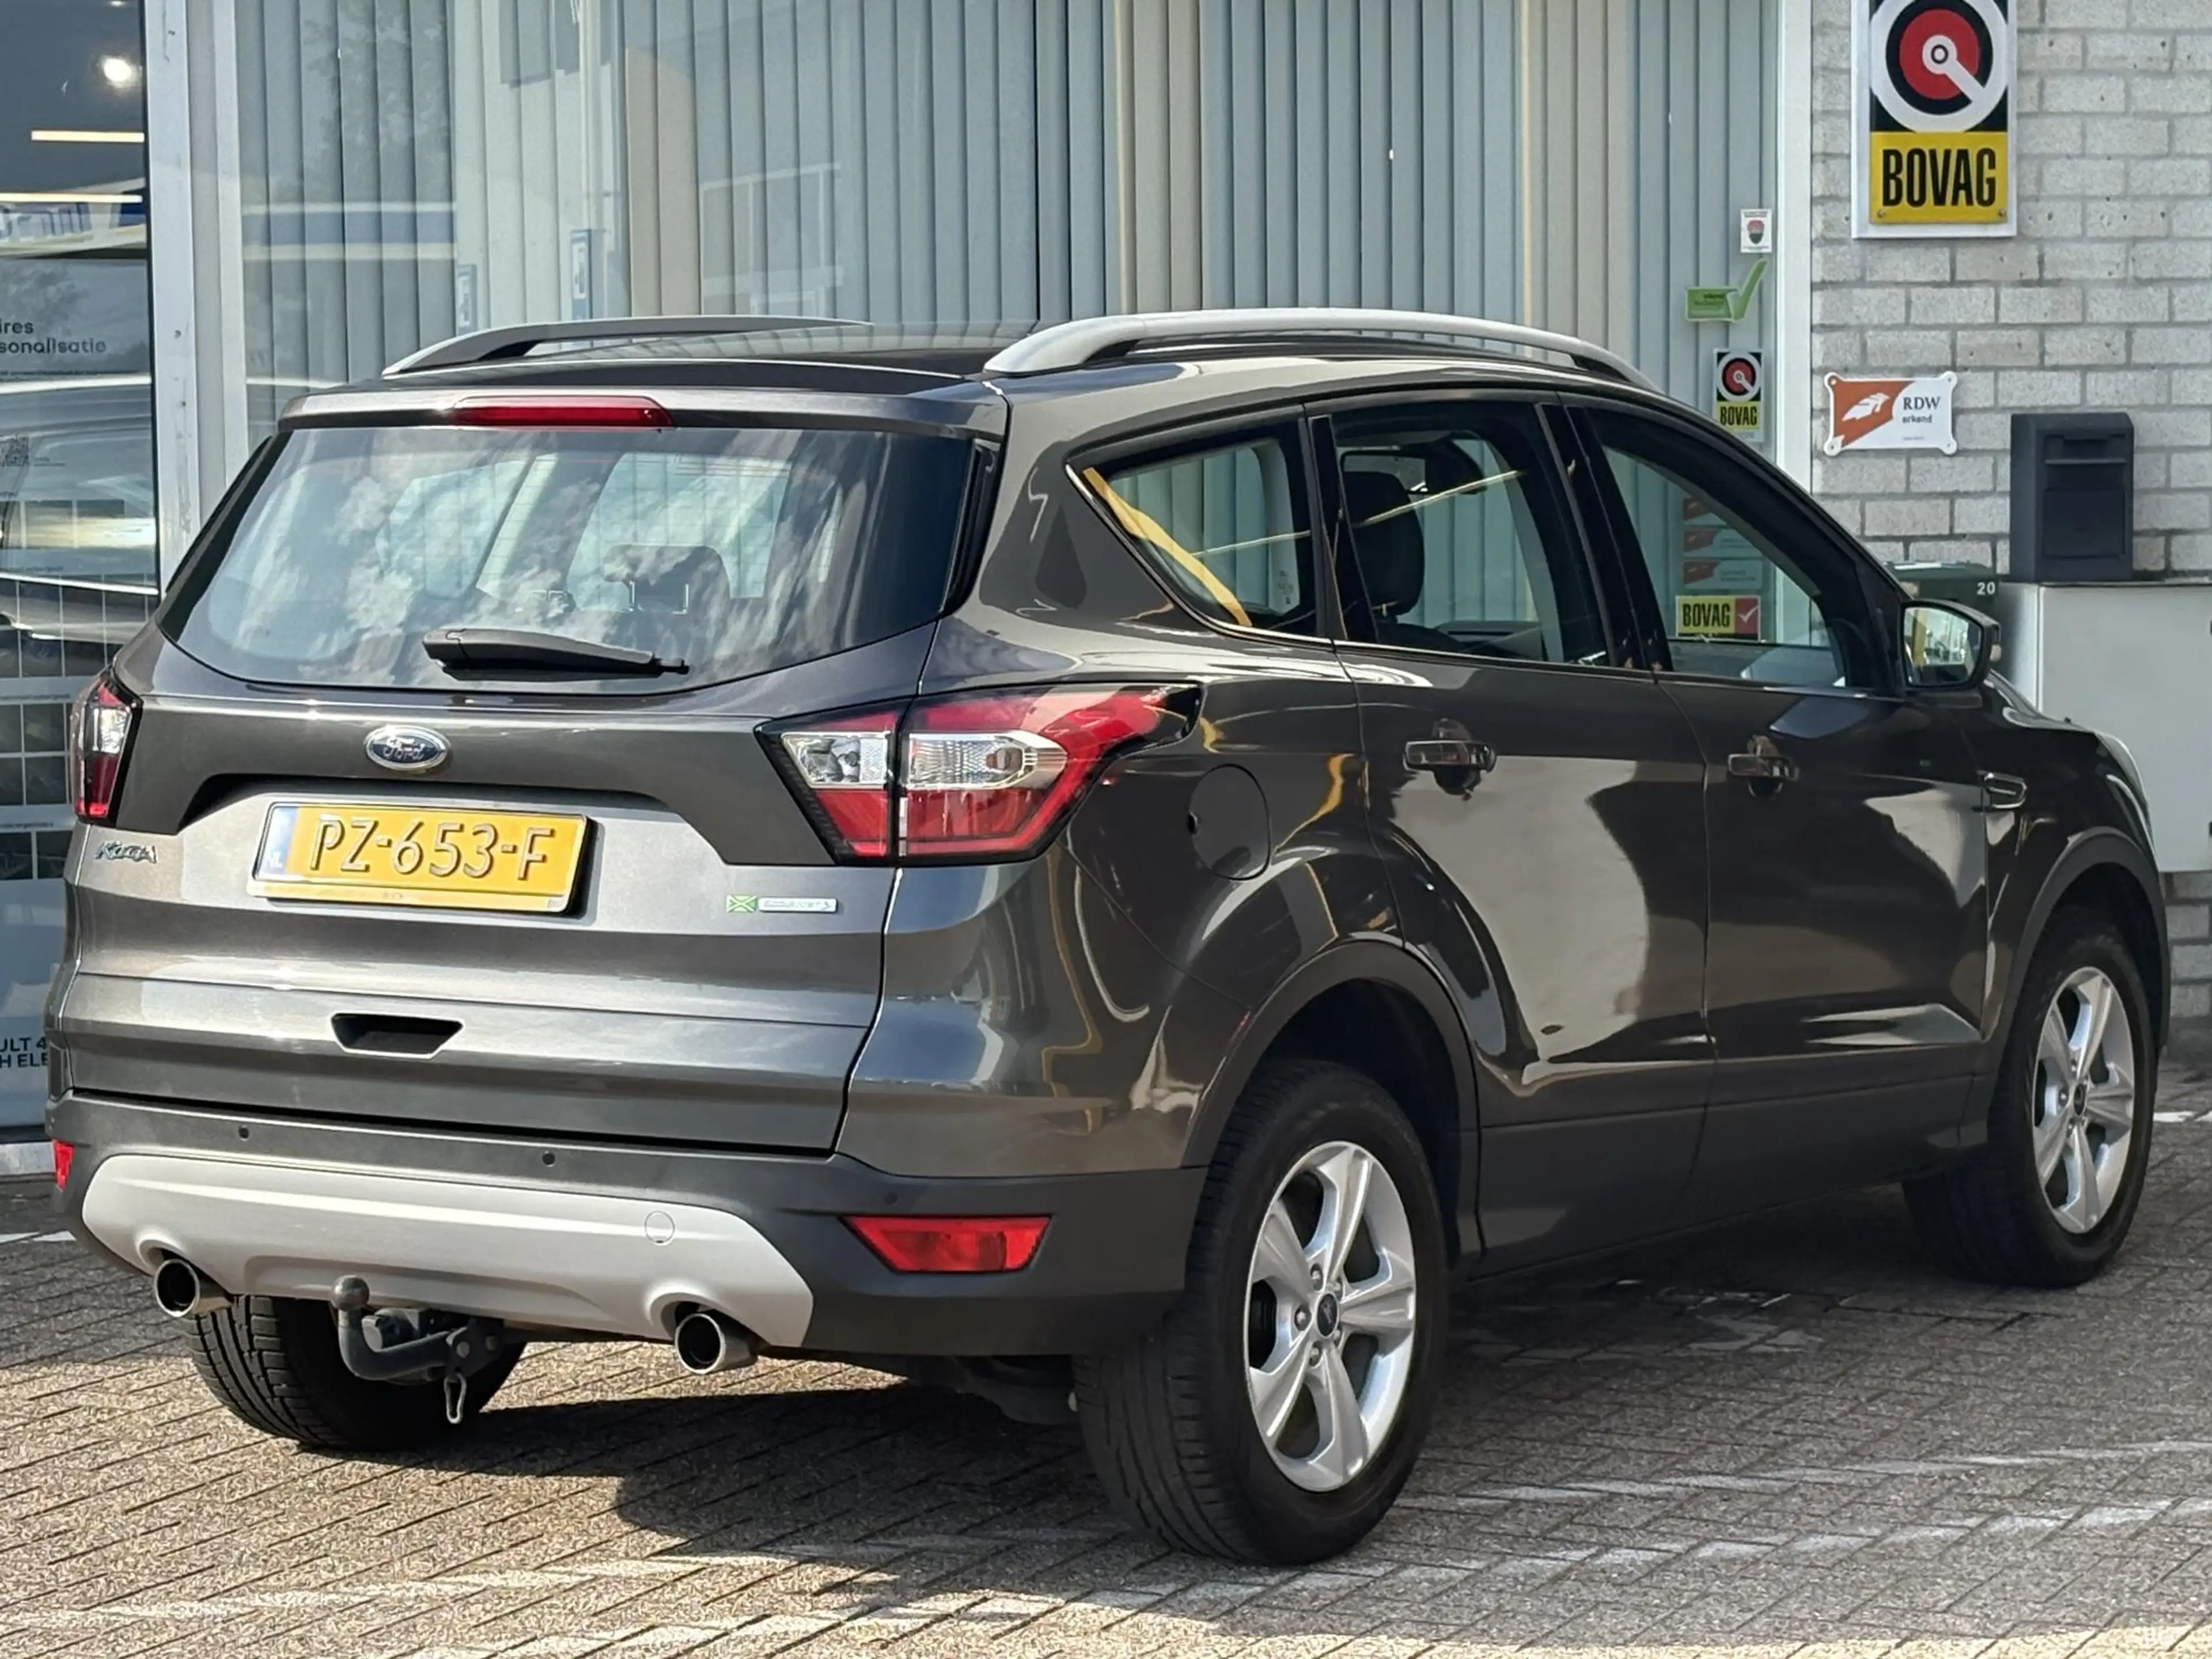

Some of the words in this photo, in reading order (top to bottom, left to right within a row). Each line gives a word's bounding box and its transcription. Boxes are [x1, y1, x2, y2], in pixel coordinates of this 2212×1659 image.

[1883, 148, 1996, 207] BOVAG
[1903, 396, 1941, 410] RDW
[1720, 406, 1758, 426] BOVAG
[1977, 581, 1995, 595] 20
[1683, 603, 1730, 627] BOVAG
[309, 813, 556, 881] PZ-653-F
[264, 850, 283, 868] NL
